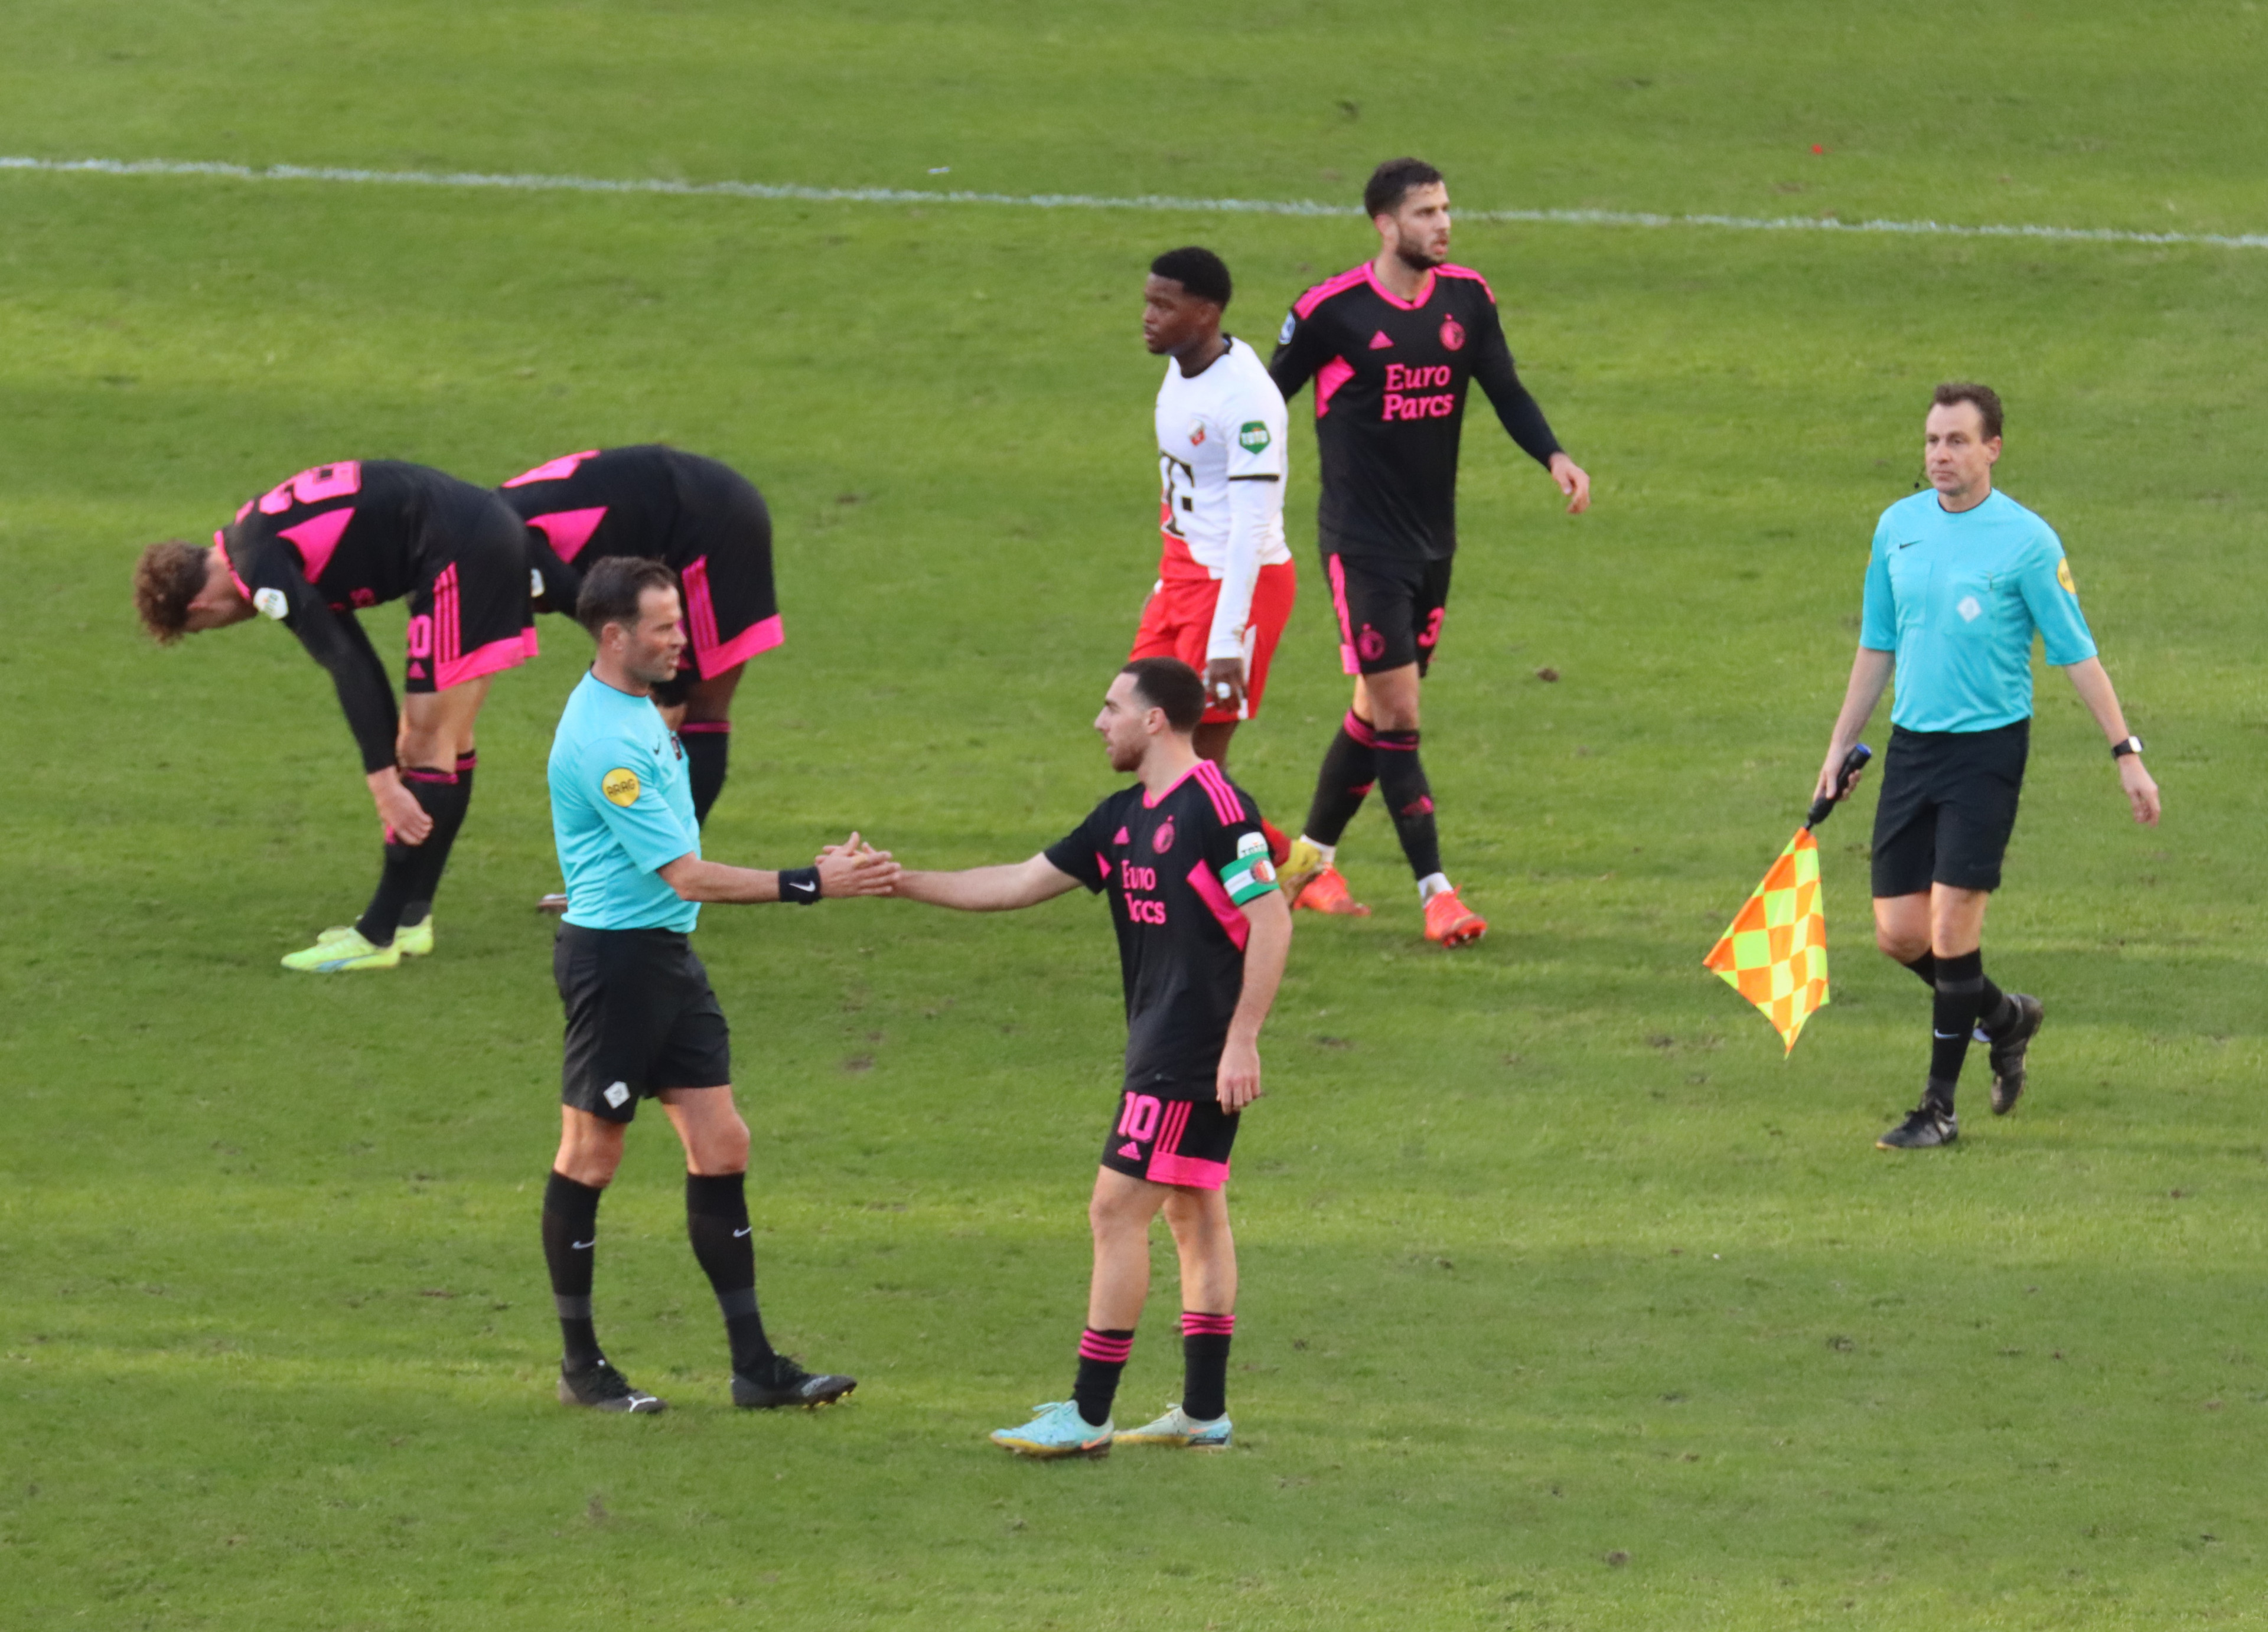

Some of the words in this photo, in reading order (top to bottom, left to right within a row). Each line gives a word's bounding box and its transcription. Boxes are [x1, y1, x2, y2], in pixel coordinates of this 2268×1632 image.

[1385, 364, 1451, 391] Euro
[1382, 394, 1454, 420] Parcs
[606, 778, 636, 797] ARAG
[1117, 1090, 1162, 1144] 10
